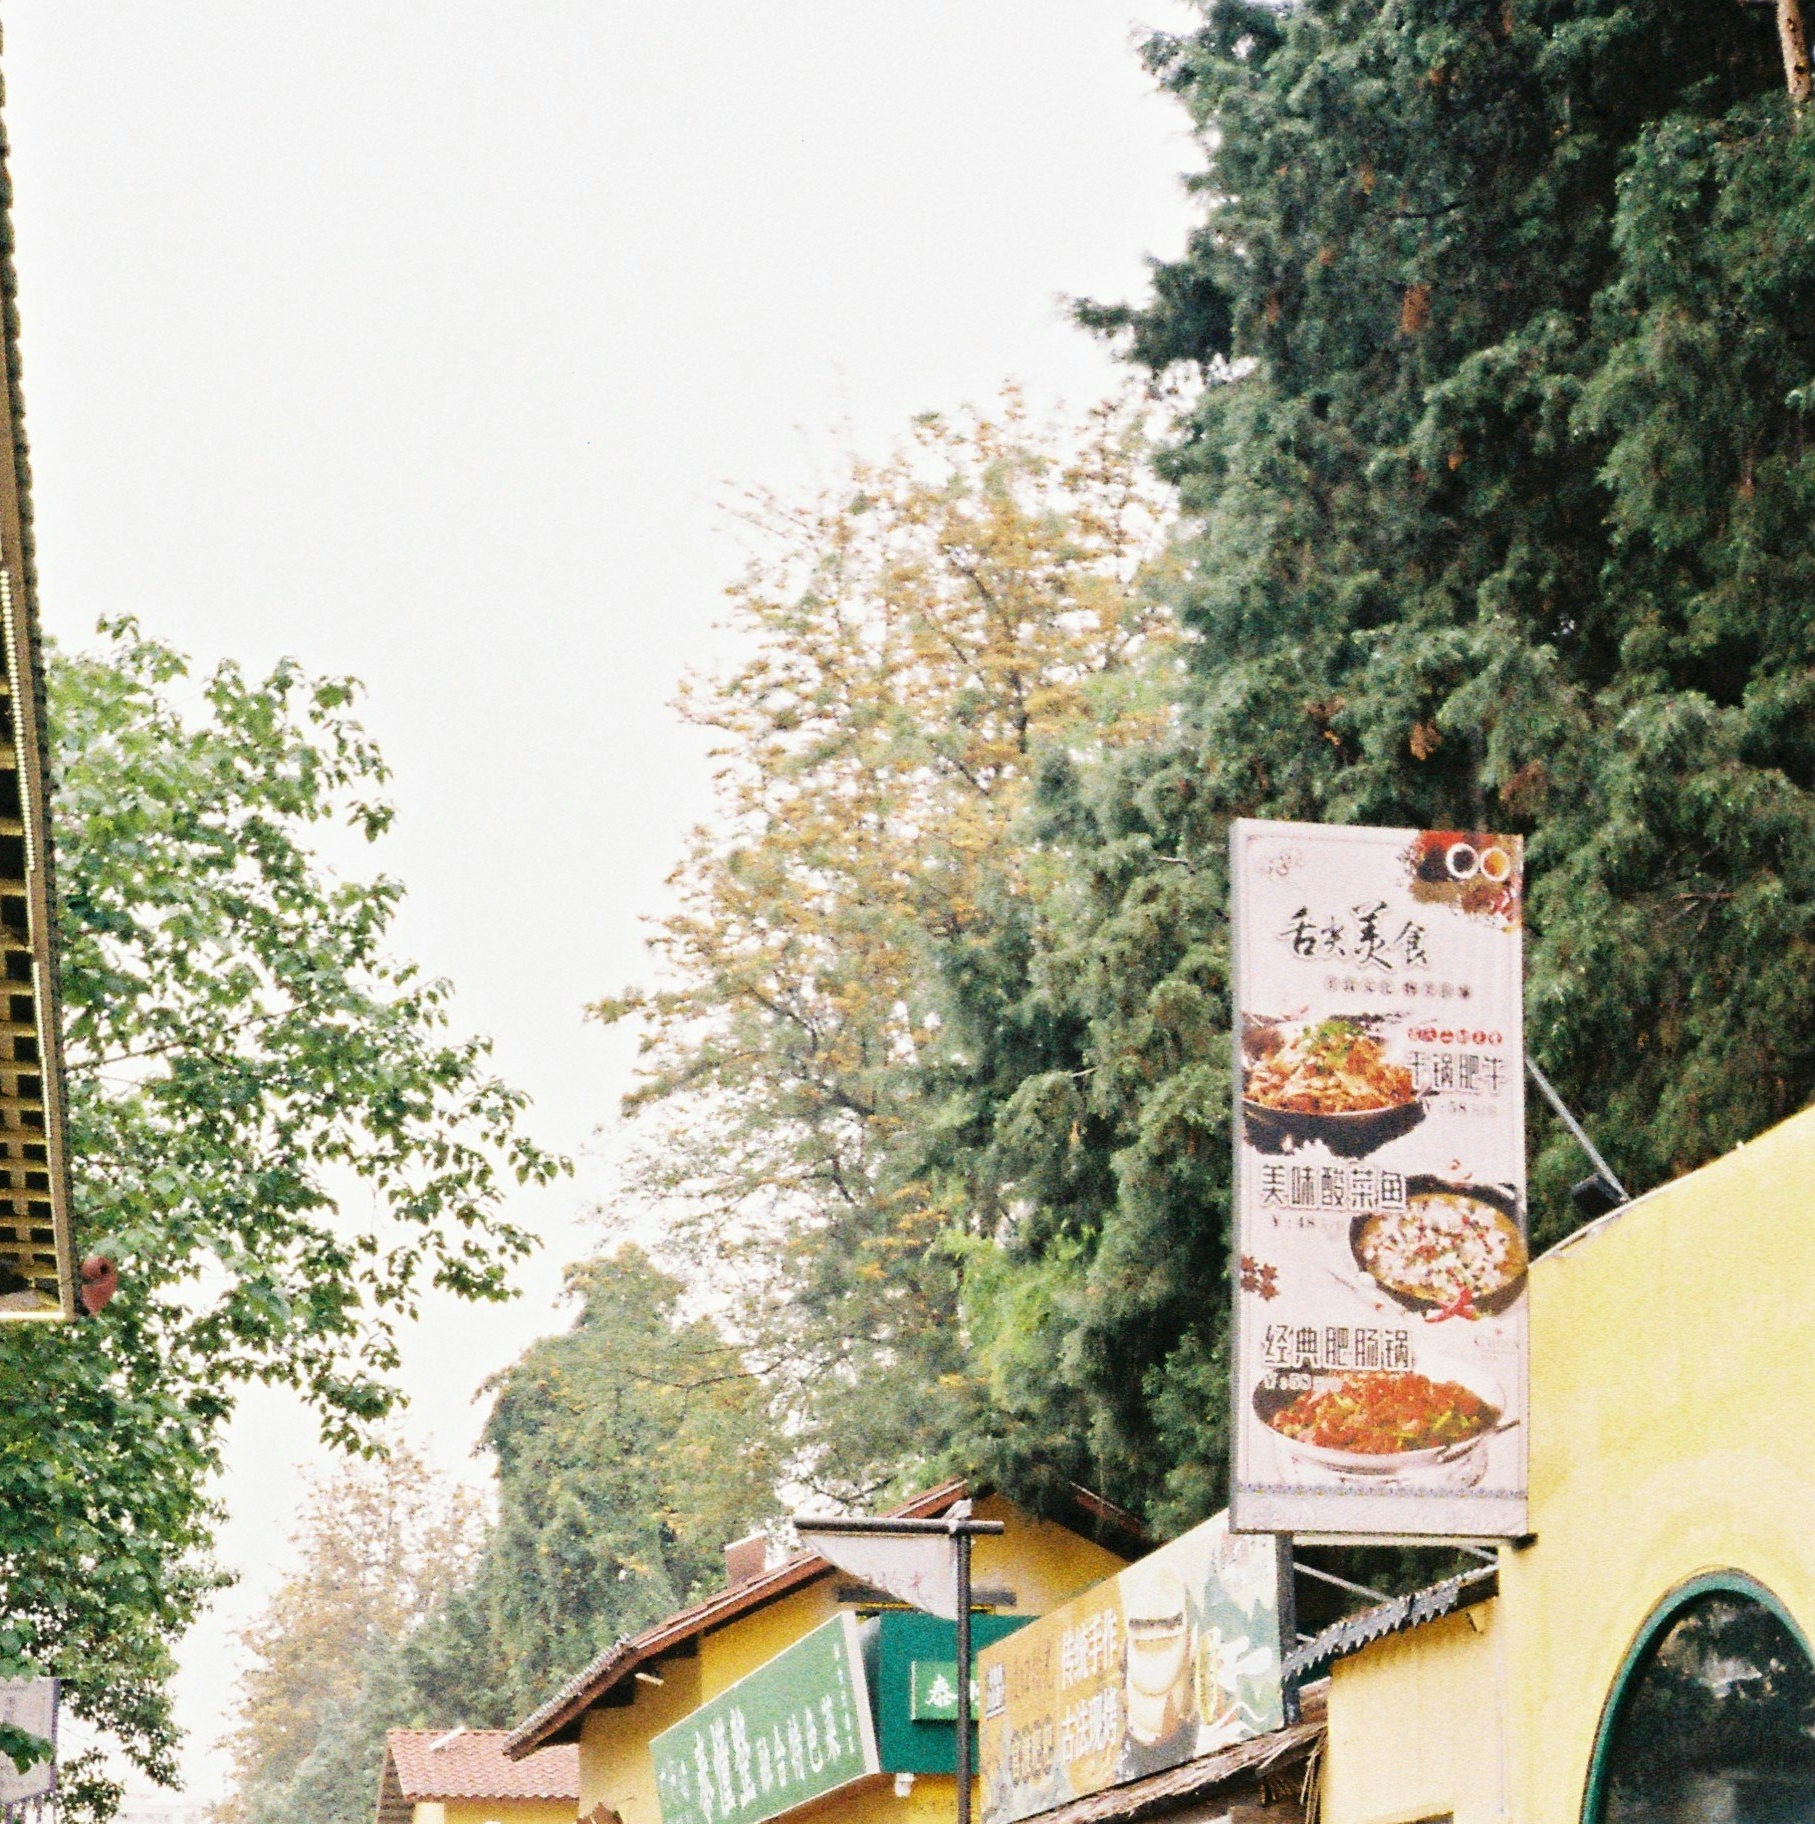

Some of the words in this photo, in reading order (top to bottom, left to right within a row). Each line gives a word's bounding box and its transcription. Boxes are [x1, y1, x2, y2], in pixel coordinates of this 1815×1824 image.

[1280, 901, 1427, 969] 舌尖美食
[1407, 1049, 1508, 1092] 干锅肥牛
[1261, 1163, 1403, 1211] 美味酸菜鱼
[1264, 1324, 1411, 1368] 经典肥肠锅
